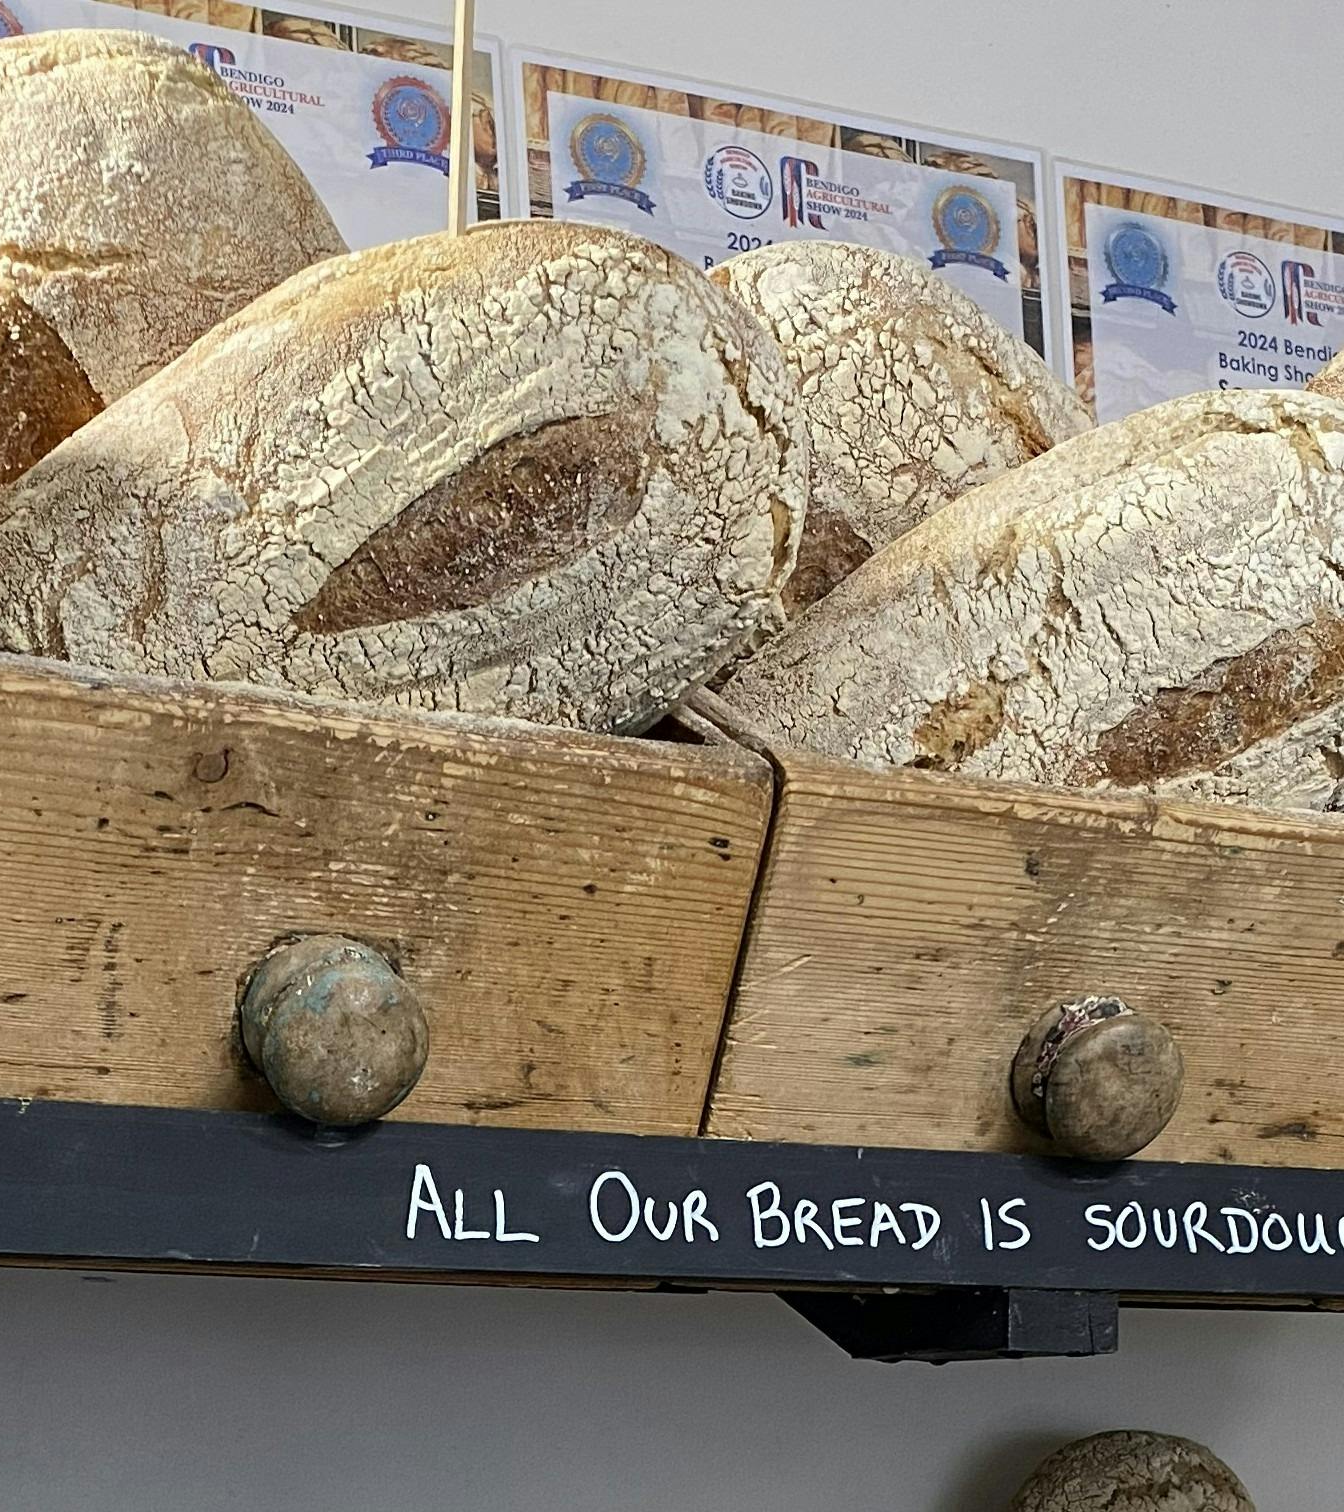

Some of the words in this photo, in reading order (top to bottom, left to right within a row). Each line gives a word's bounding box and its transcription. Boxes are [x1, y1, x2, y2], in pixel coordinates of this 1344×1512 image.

[220, 66, 285, 88] BENDIGO
[228, 80, 325, 107] GRICULTURAL
[266, 100, 296, 115] 2024
[381, 149, 414, 159] THIRD
[806, 178, 860, 197] BENDIGO
[806, 191, 892, 215] AGRICULTURAL
[806, 201, 842, 217] SHOW
[844, 209, 869, 222] 2024
[727, 232, 773, 252] 202
[1304, 301, 1335, 314] SHOW
[1238, 330, 1278, 353] 2024
[1284, 339, 1339, 362] Bendi
[1219, 352, 1279, 382] Baking
[1284, 364, 1315, 385] Sho
[406, 1163, 539, 1242] ALL
[588, 1170, 719, 1244] OUR
[746, 1180, 942, 1252] BREAD
[980, 1197, 1032, 1252] IS
